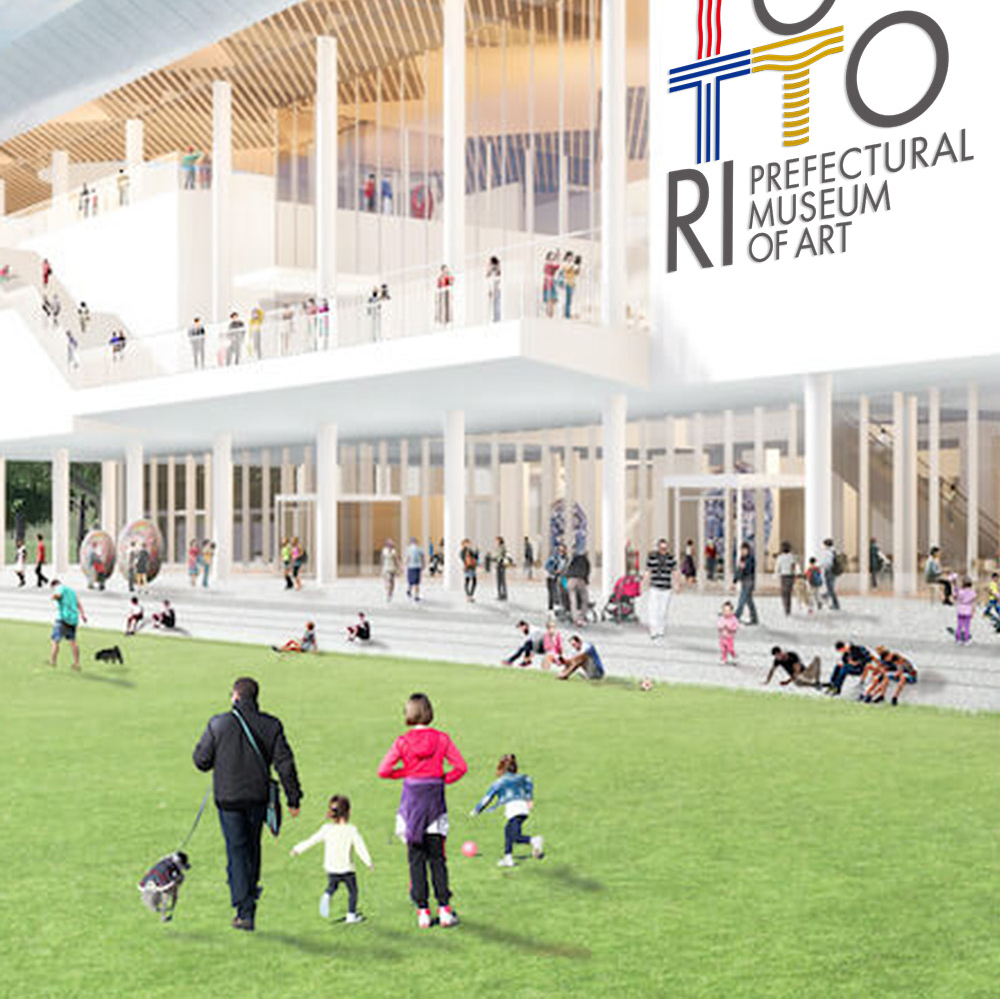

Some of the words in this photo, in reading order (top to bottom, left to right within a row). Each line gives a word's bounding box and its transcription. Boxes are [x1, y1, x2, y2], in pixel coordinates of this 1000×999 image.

[751, 128, 974, 195] PREFECTURAL
[667, 160, 734, 273] RI
[748, 180, 891, 230] MUSEUM
[748, 229, 788, 263] OF
[795, 221, 852, 258] ART
